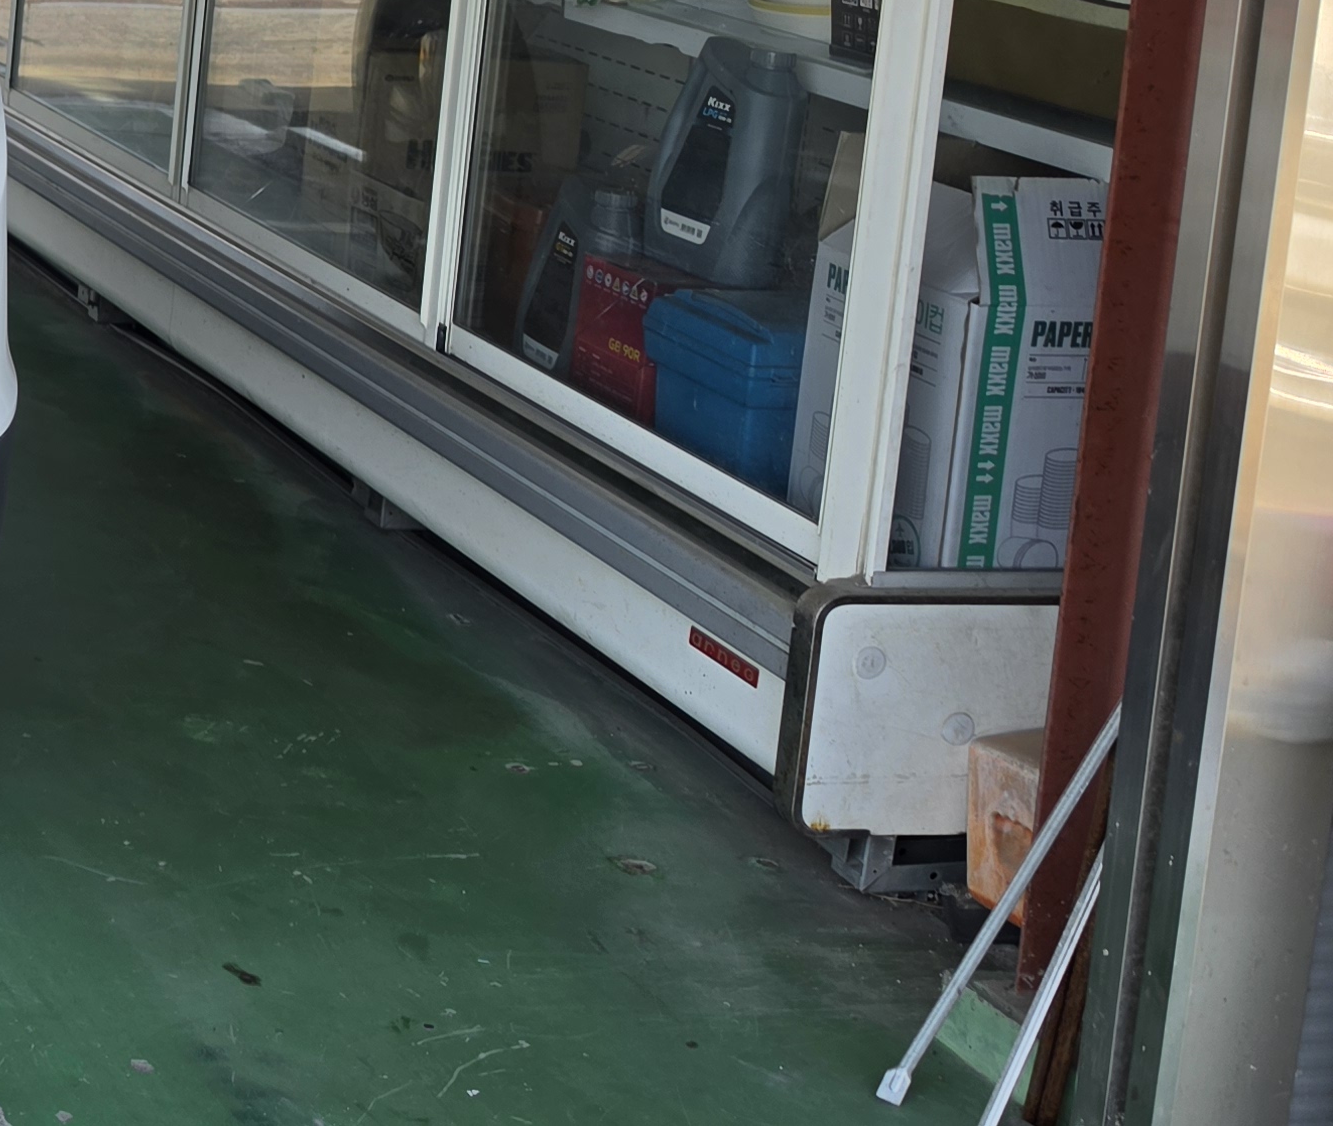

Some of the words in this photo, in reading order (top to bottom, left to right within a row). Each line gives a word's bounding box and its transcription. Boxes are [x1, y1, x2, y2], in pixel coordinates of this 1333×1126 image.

[707, 96, 731, 113] Kixx
[992, 223, 1015, 275] maxx
[993, 285, 1017, 335] maxx
[986, 346, 1011, 396] maxx
[979, 405, 1003, 456] maxx
[968, 495, 992, 545] maxx
